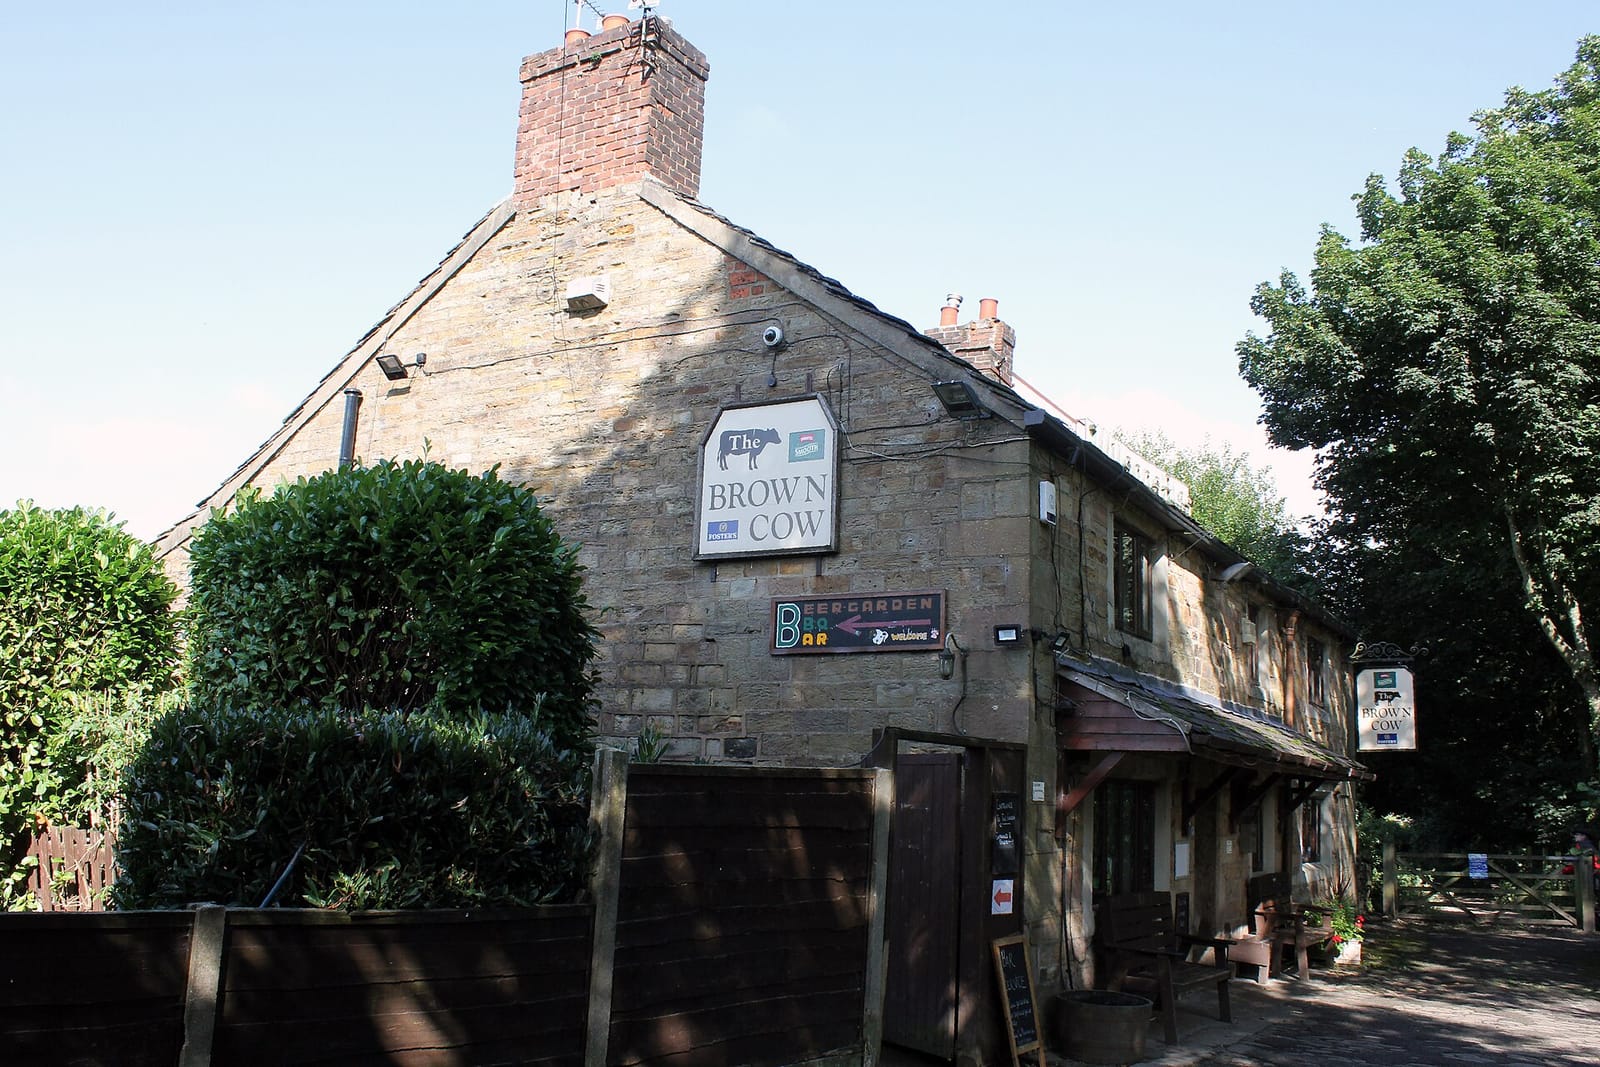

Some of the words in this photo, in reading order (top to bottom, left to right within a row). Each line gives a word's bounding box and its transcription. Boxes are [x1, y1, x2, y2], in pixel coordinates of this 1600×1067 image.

[729, 434, 761, 451] The
[709, 474, 828, 511] BROWN
[749, 510, 825, 541] COW
[848, 598, 933, 612] GARDEN
[890, 631, 928, 642] WELCOME
[1378, 692, 1393, 700] The
[1362, 707, 1411, 718] BROWN
[1371, 720, 1402, 731] COW
